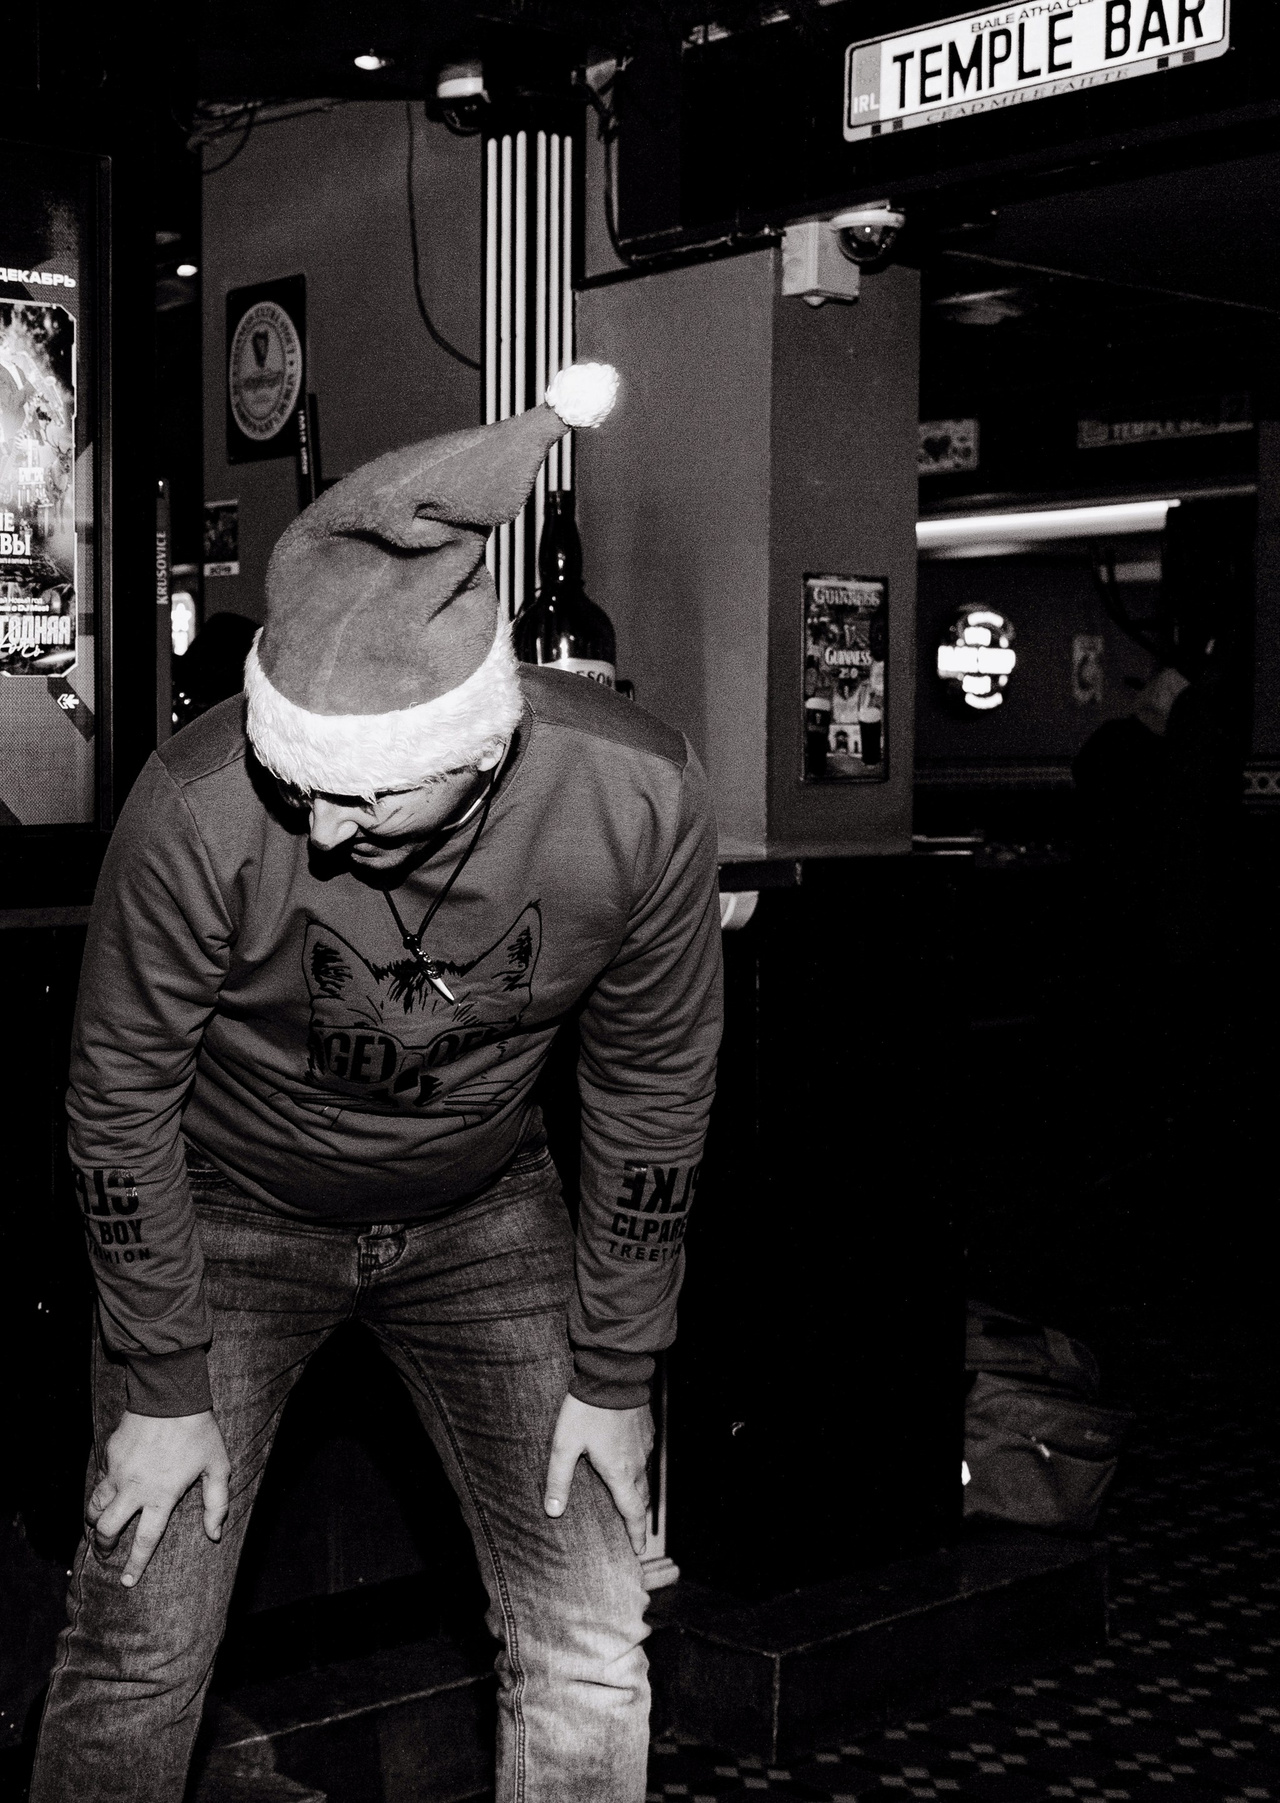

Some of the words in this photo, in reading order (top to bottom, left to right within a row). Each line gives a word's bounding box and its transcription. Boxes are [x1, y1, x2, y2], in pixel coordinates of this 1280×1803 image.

[971, 12, 1015, 33] BAILE
[893, 9, 1073, 110] TEMPLE
[1105, 0, 1205, 60] BAR
[853, 92, 880, 115] IRL
[99, 1219, 142, 1245] BOY
